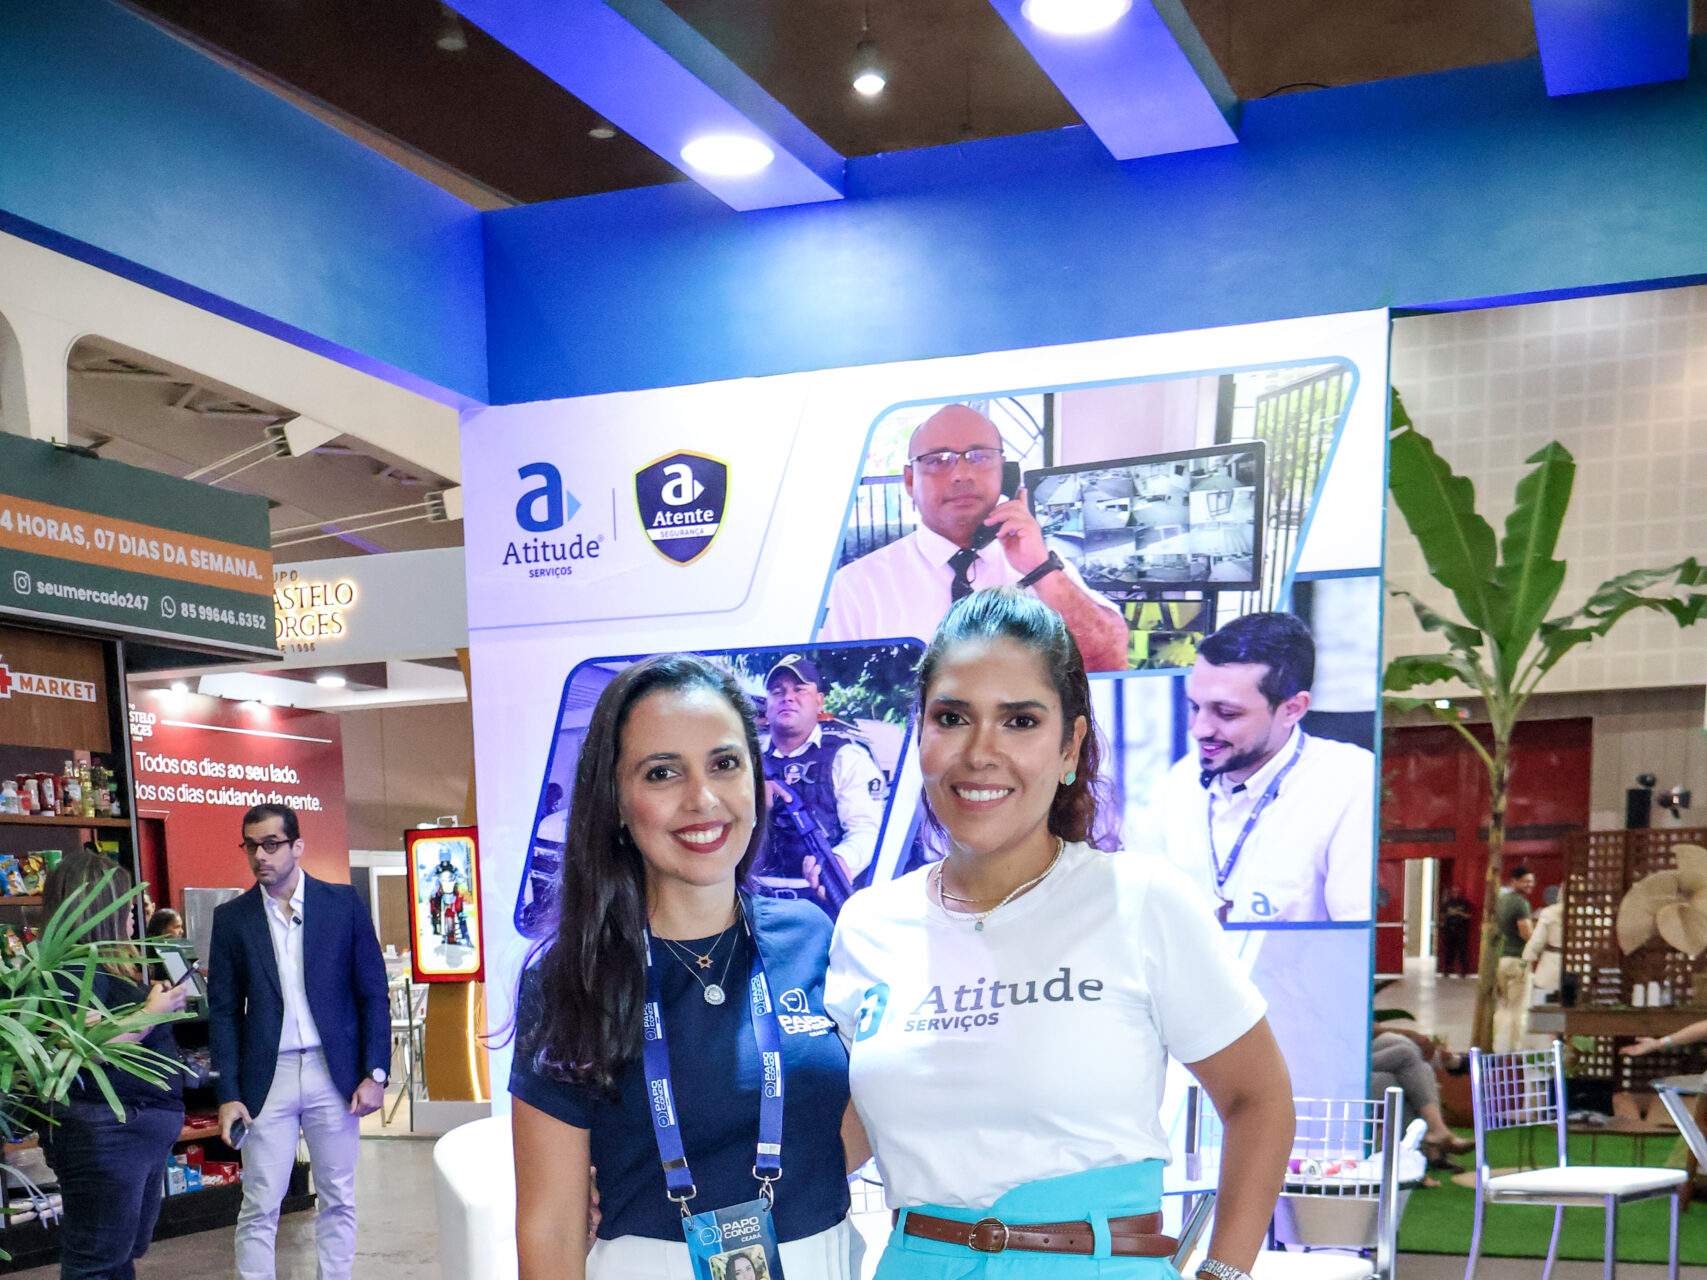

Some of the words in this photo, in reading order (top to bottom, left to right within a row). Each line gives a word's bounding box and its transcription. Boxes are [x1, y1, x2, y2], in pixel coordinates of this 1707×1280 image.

[652, 508, 715, 527] Atente
[17, 512, 91, 549] HORAS,
[94, 528, 116, 552] 07
[118, 533, 160, 561] DIAS
[162, 542, 188, 566] DA
[190, 548, 263, 580] SEMANA.
[660, 528, 705, 538] SEGURANÇA
[502, 534, 600, 565] Atitude
[529, 566, 572, 579] SERVIÇOS
[36, 581, 150, 611] seumercado247
[181, 602, 197, 619] 85
[198, 605, 266, 630] 99646.6352
[19, 675, 93, 699] MARKET
[136, 751, 180, 774] Todos
[181, 759, 198, 776] os
[199, 757, 226, 778] dias
[227, 763, 245, 780] ao
[245, 764, 269, 782] seu
[270, 763, 301, 784] lado.
[158, 785, 176, 802] os
[177, 784, 205, 804] dias
[206, 786, 266, 808] cuidando
[909, 967, 1104, 1016] Atitude
[903, 1012, 999, 1032] SERVIÇOS
[651, 1080, 662, 1112] PAPO
[657, 1080, 667, 1111] CONDO
[722, 1216, 759, 1232] PAPO
[724, 1225, 761, 1239] CONDO
